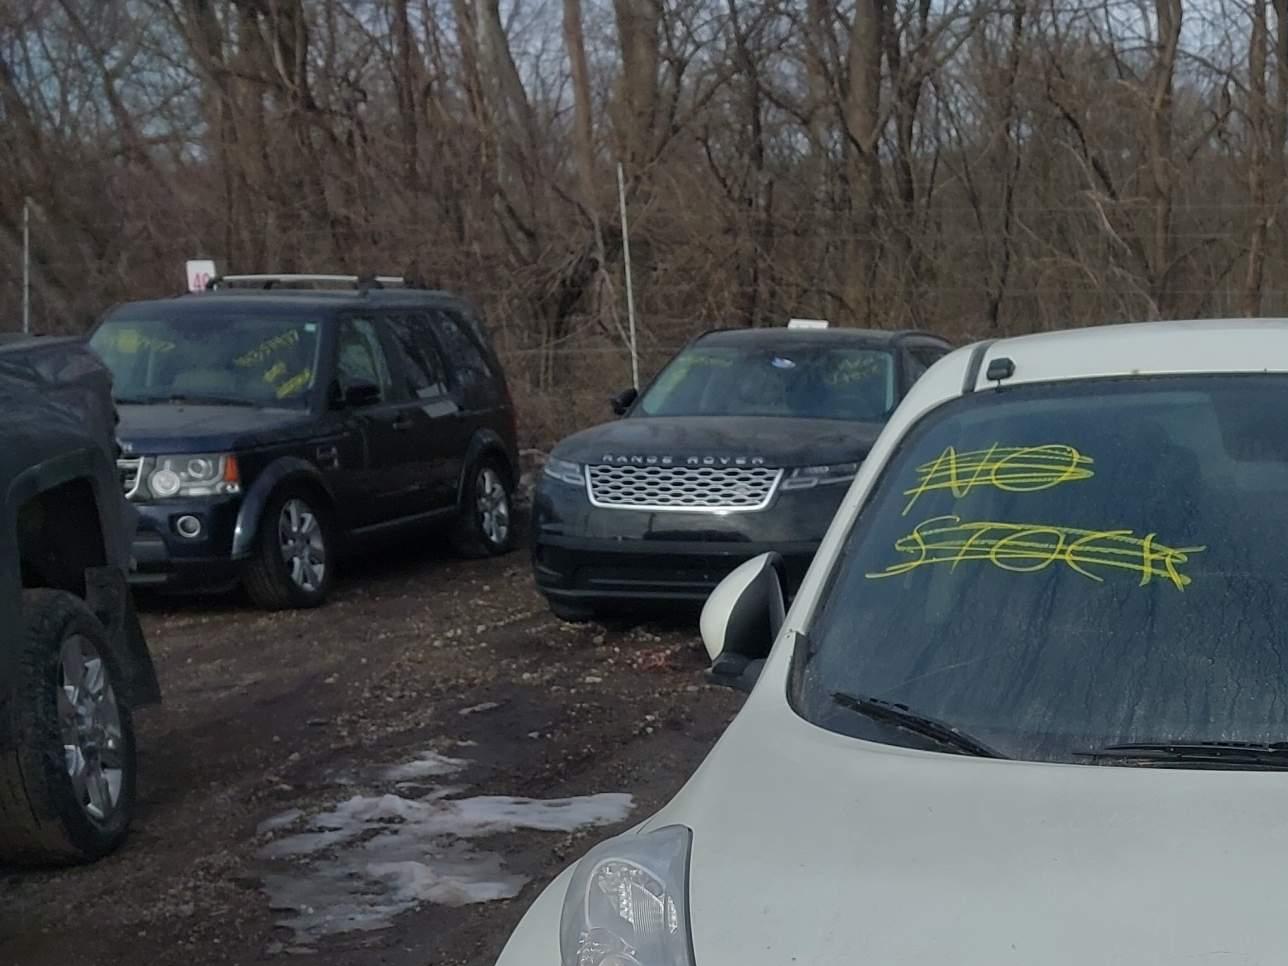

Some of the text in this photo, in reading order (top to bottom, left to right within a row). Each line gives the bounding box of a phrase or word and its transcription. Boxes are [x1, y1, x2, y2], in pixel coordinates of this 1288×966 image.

[602, 453, 764, 466] RANGE ROVER
[901, 441, 1094, 516] NO
